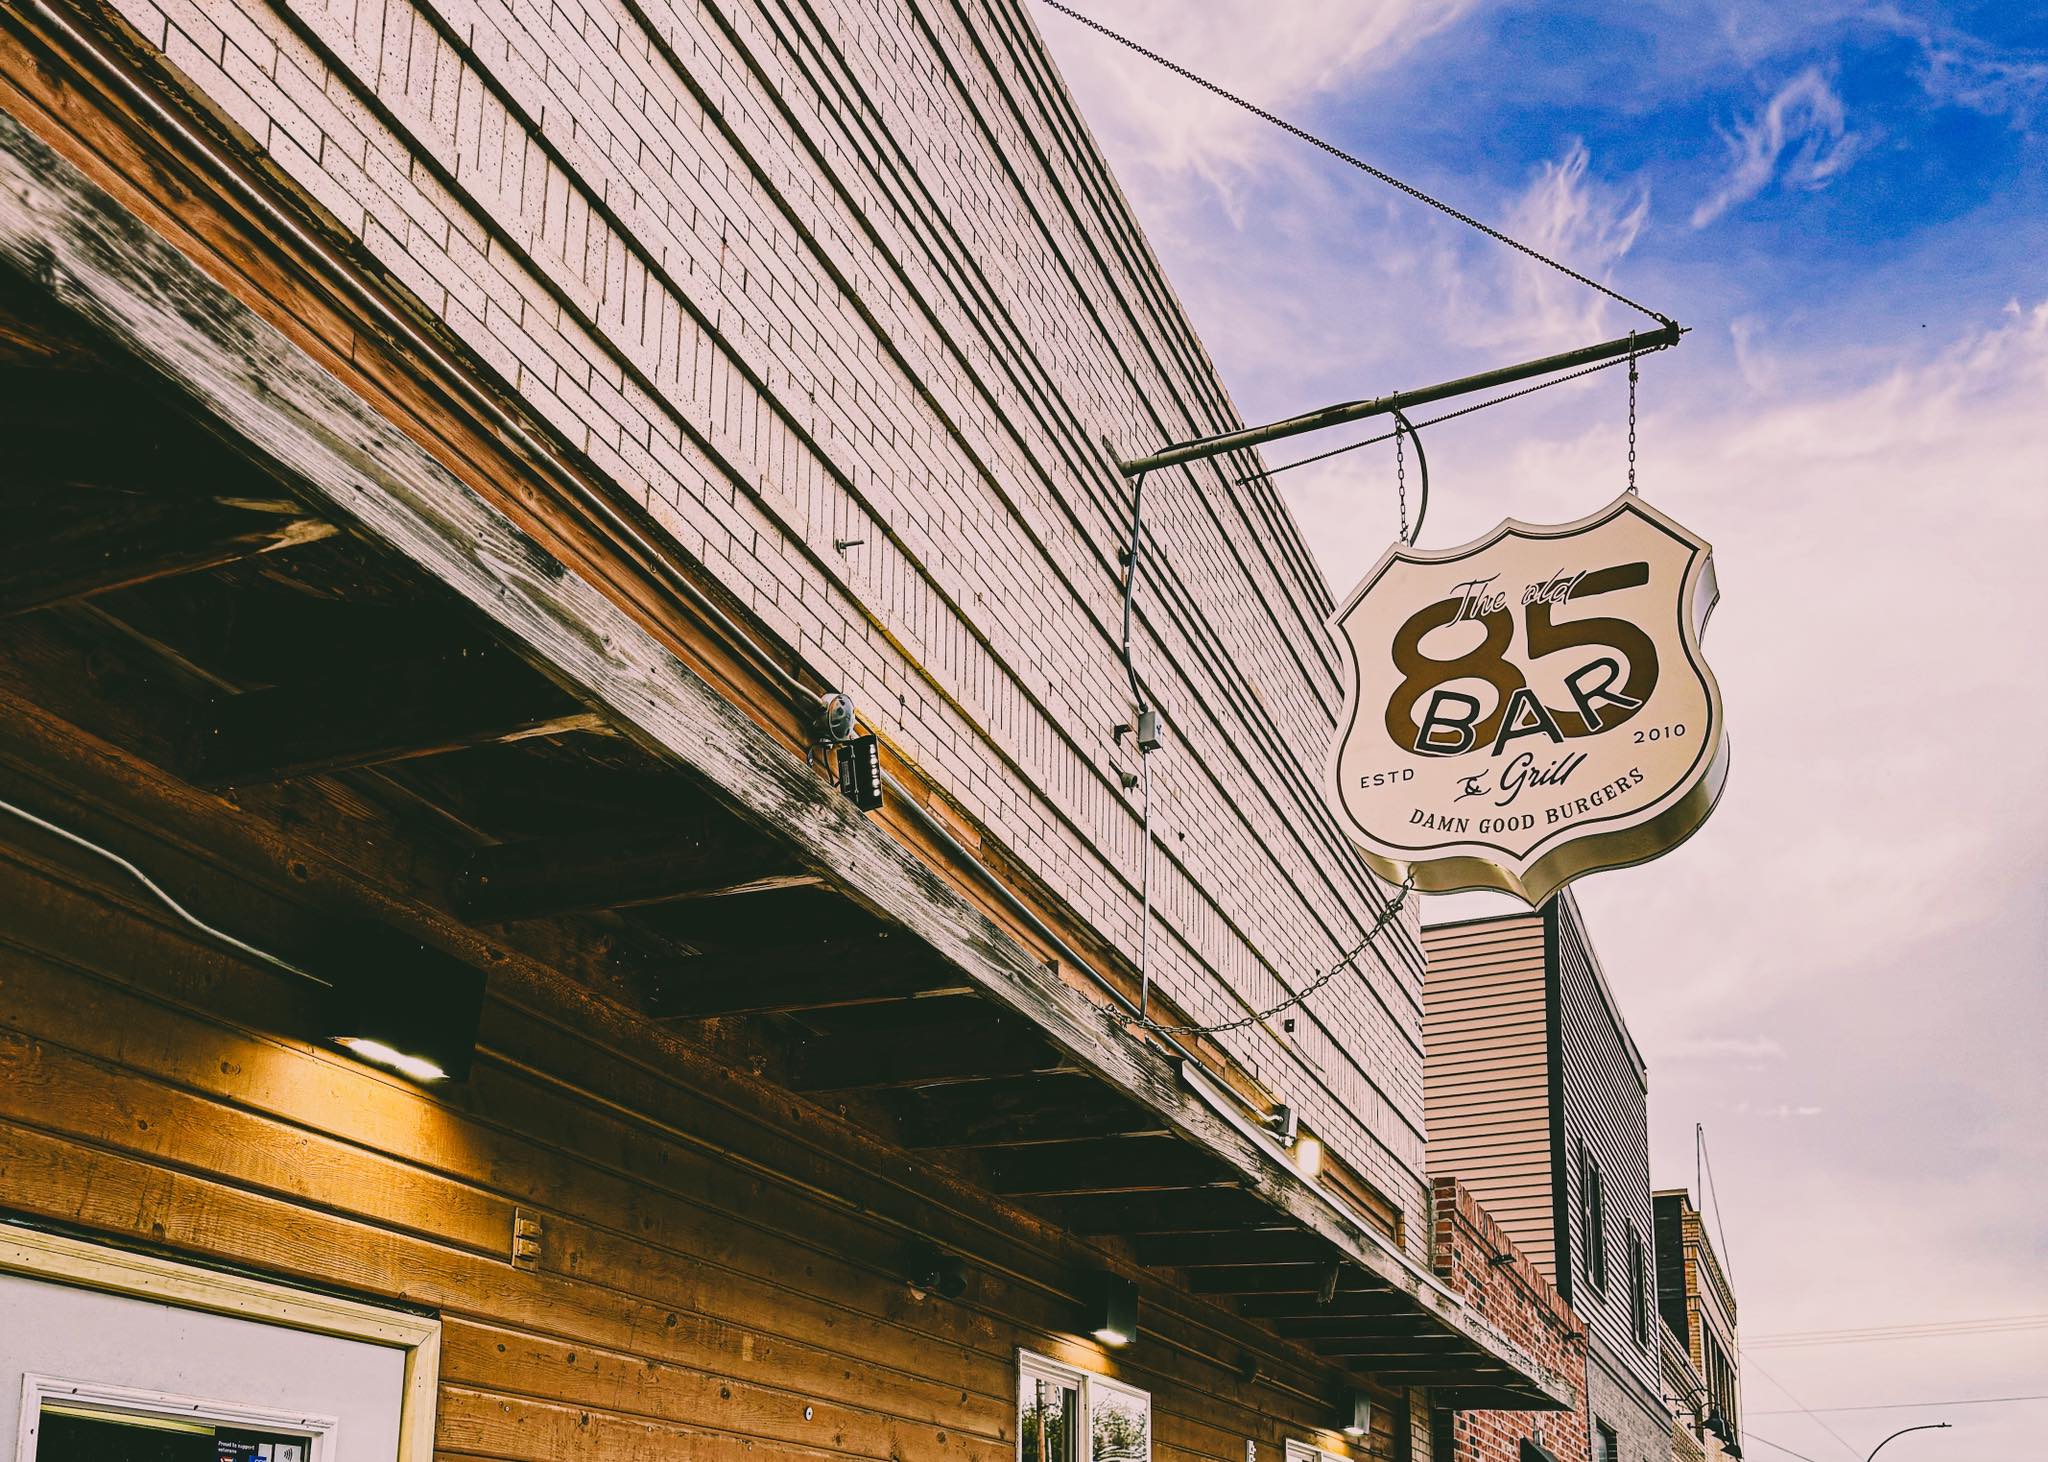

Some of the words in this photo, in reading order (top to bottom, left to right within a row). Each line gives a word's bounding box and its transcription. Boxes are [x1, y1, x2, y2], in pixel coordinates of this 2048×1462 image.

[1446, 572, 1507, 628] The
[1521, 568, 1587, 605] old
[1385, 561, 1660, 758] 85
[1414, 656, 1641, 757] BAR
[1633, 723, 1686, 745] 2010
[1360, 767, 1415, 789] ESTD
[1409, 808, 1469, 833] DAMN
[1479, 813, 1535, 834] GOOD
[1545, 767, 1645, 824] BURGERS
[1495, 752, 1588, 806] Grill
